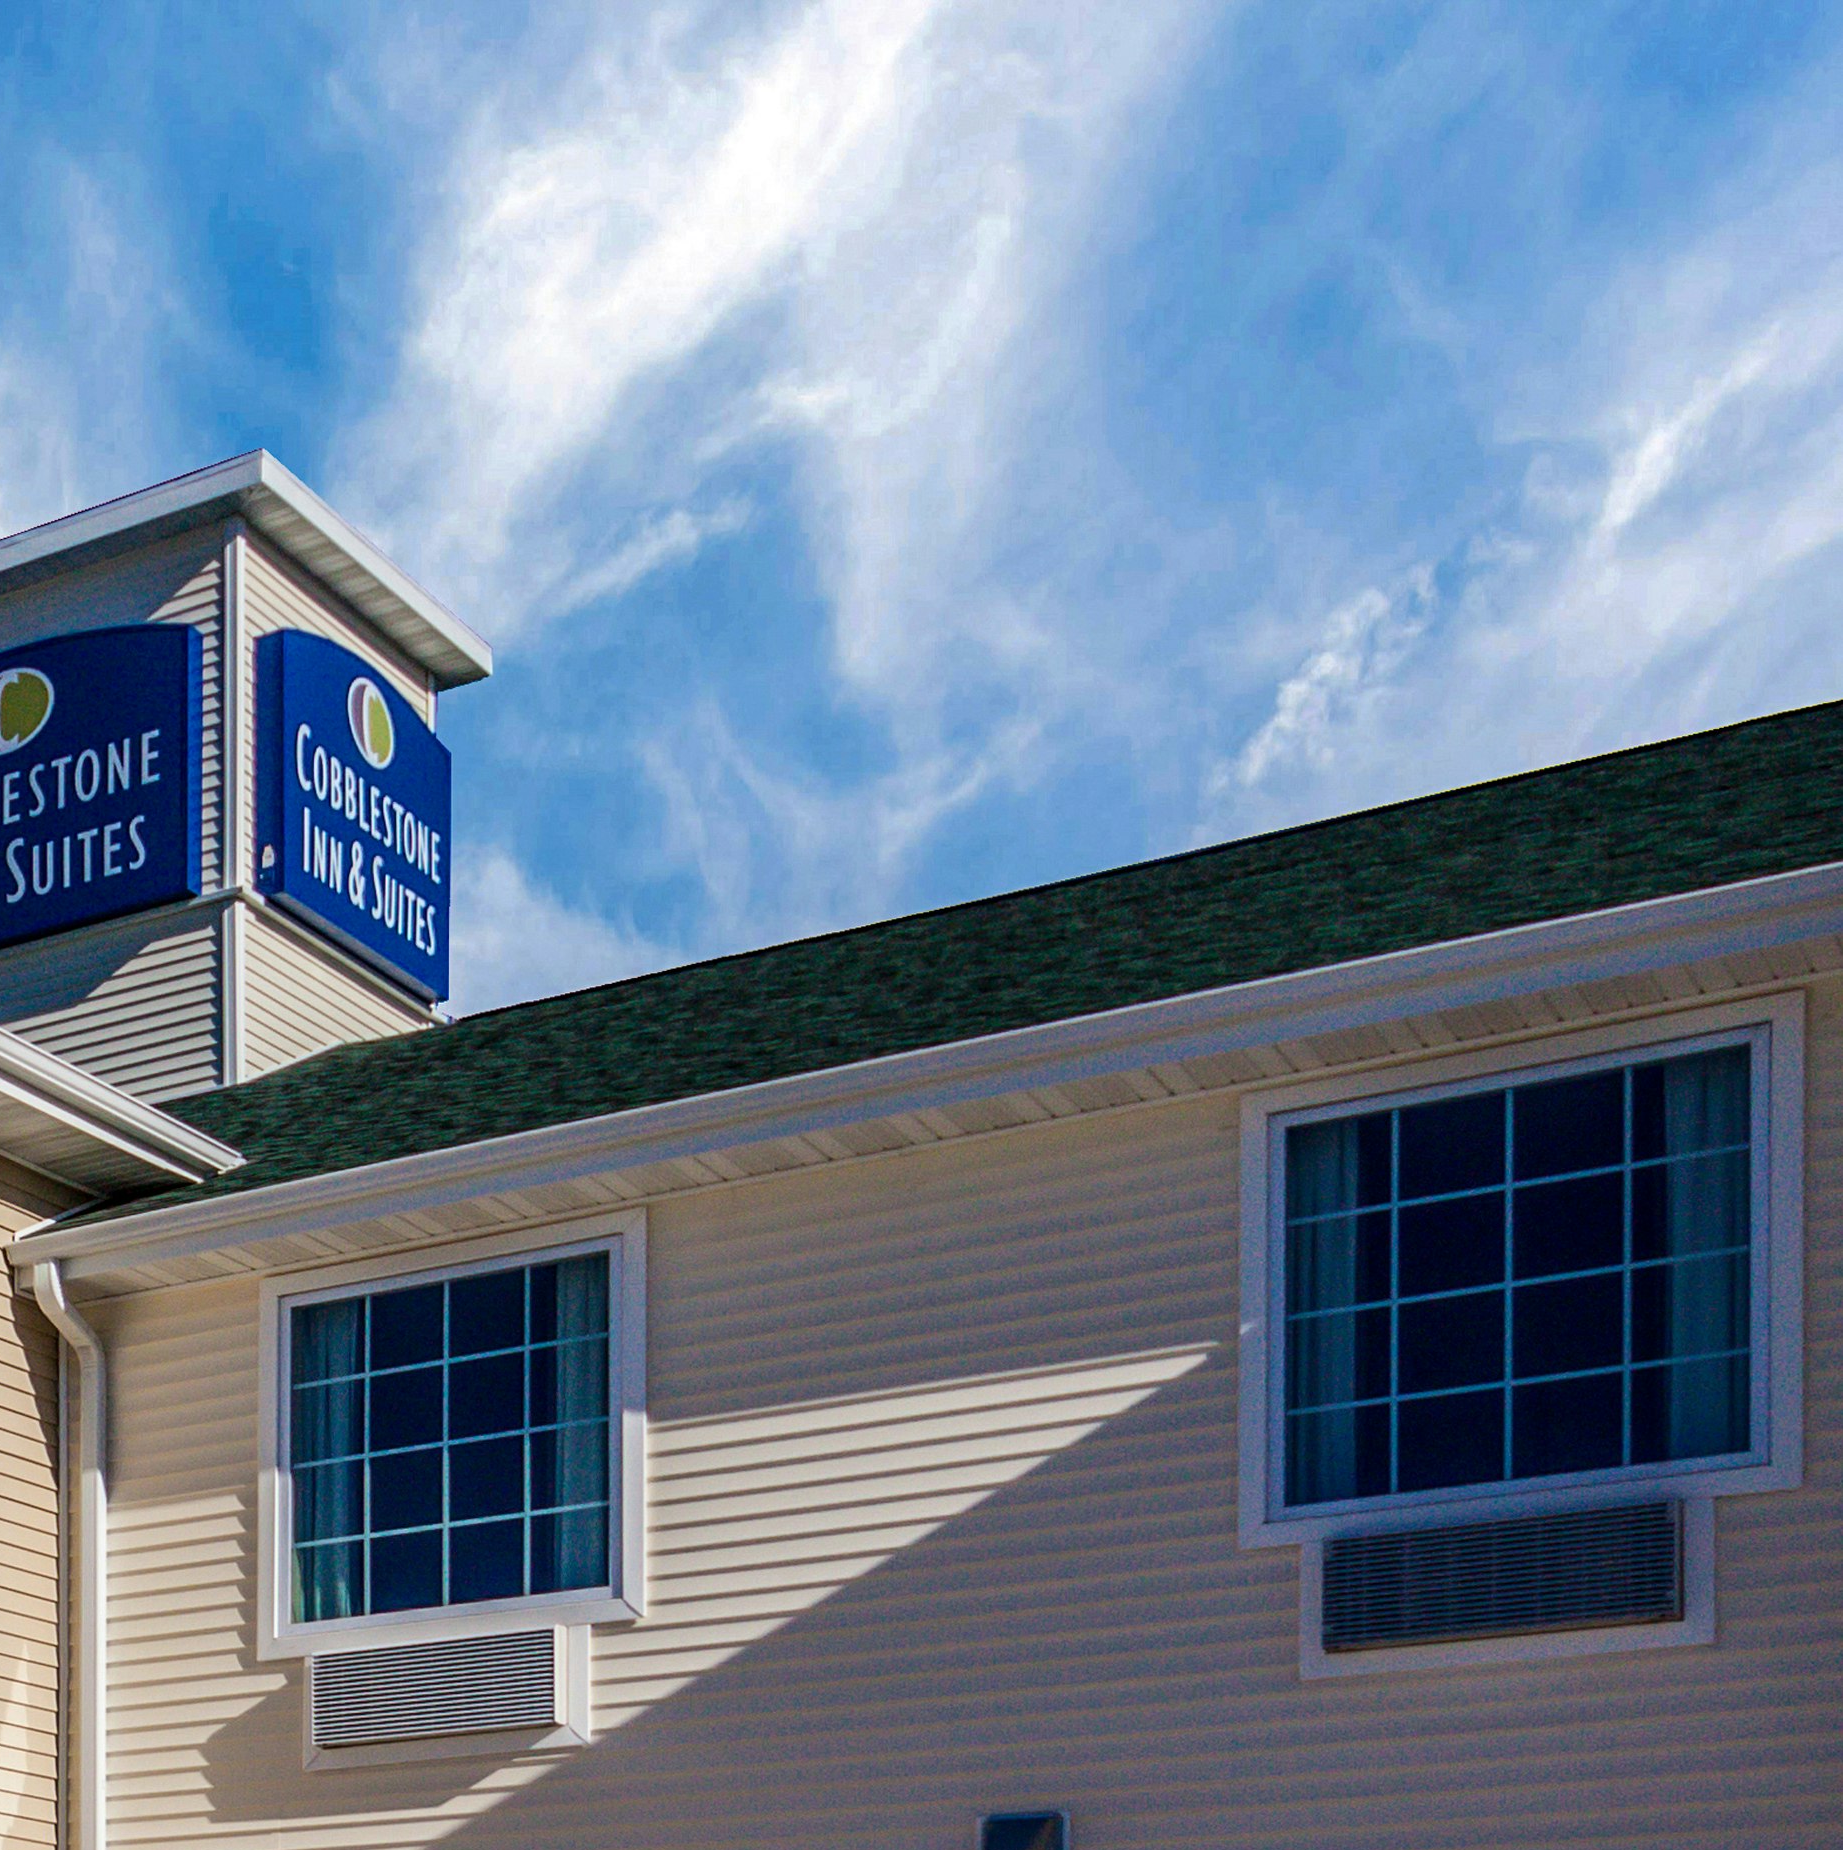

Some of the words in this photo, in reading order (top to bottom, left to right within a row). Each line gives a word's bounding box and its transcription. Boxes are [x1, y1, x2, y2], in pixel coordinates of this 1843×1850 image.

[5, 815, 146, 903] SUITES
[296, 723, 441, 884] COBBLESTONE
[303, 807, 342, 894] INN
[348, 840, 365, 910] &
[372, 855, 436, 957] SUITES
